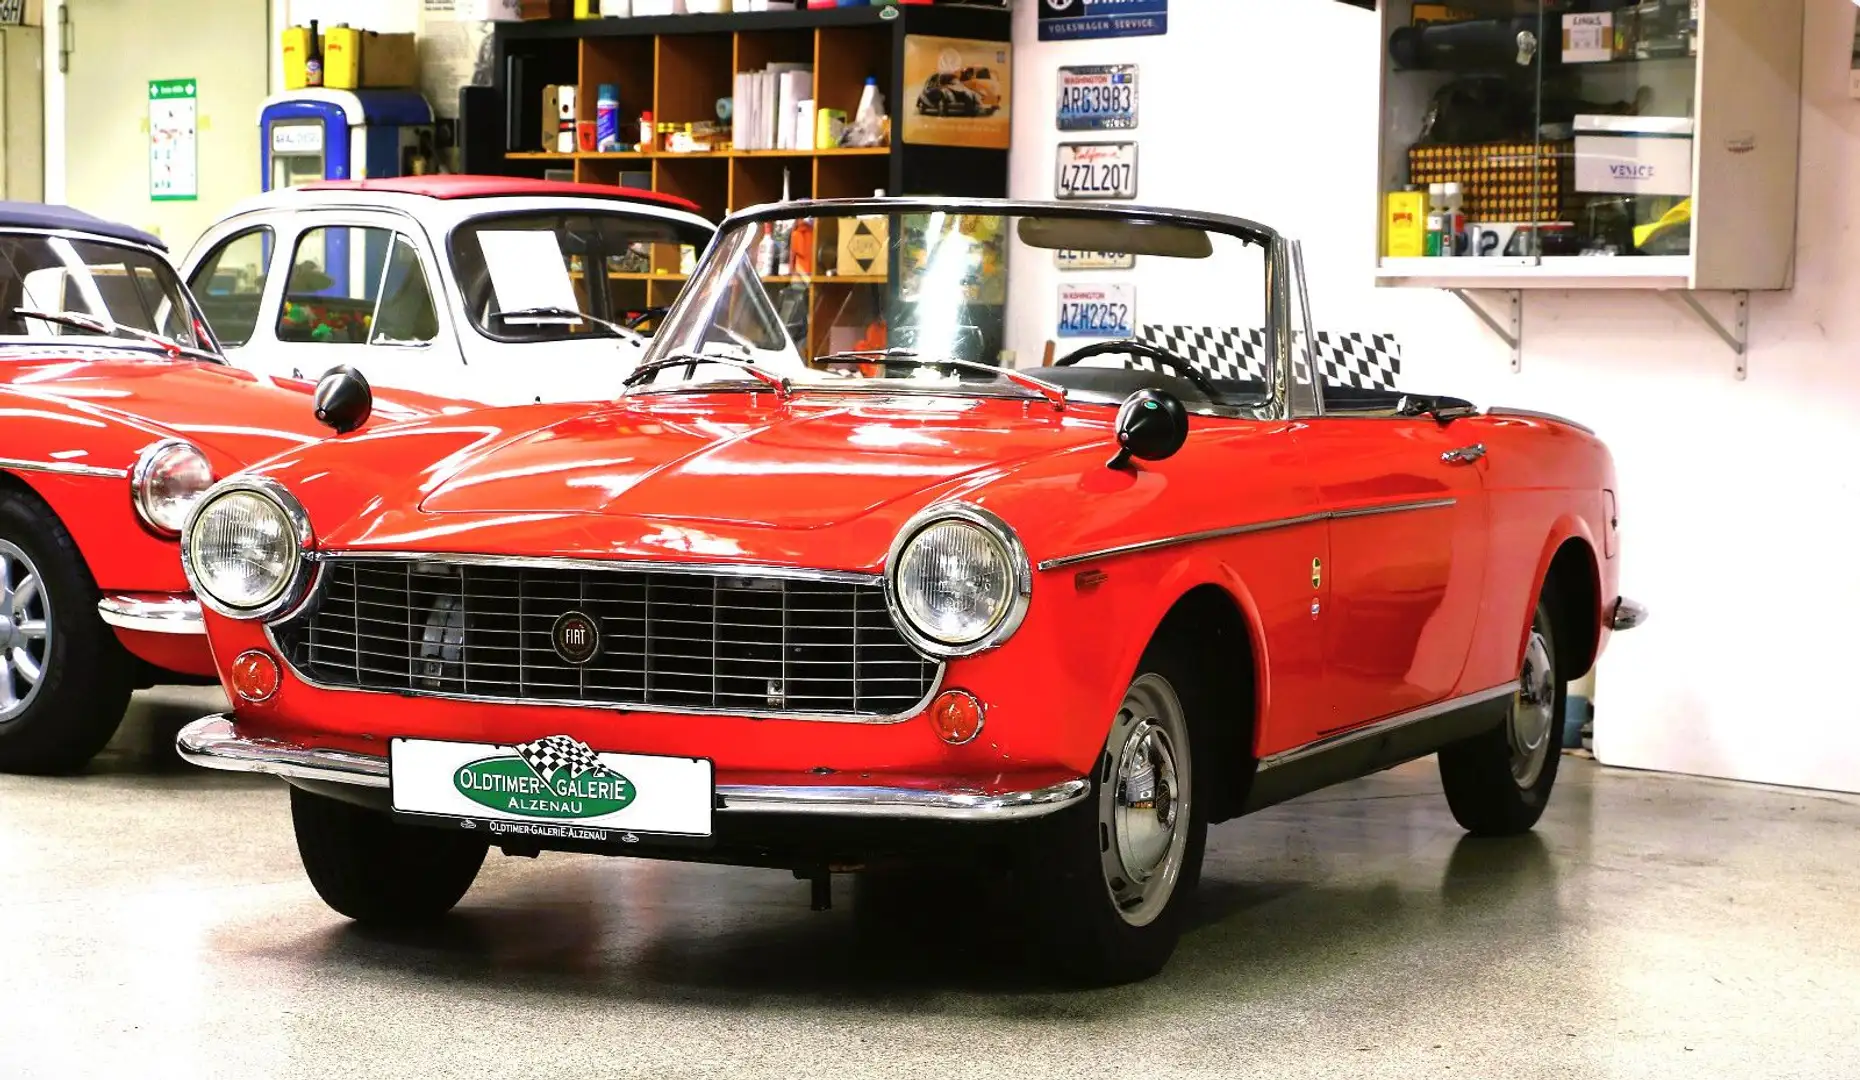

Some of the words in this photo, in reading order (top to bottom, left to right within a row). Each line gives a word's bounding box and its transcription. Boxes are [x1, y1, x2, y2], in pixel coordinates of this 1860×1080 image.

[1048, 22, 1109, 33] VOLKSWAGEN
[1114, 19, 1153, 29] SERVICE
[1061, 163, 1130, 191] 4ZZL207
[1060, 303, 1127, 330] AZH2252
[566, 628, 586, 645] FIAT
[556, 779, 627, 801] GALERIE
[508, 797, 583, 814] ALZENAU
